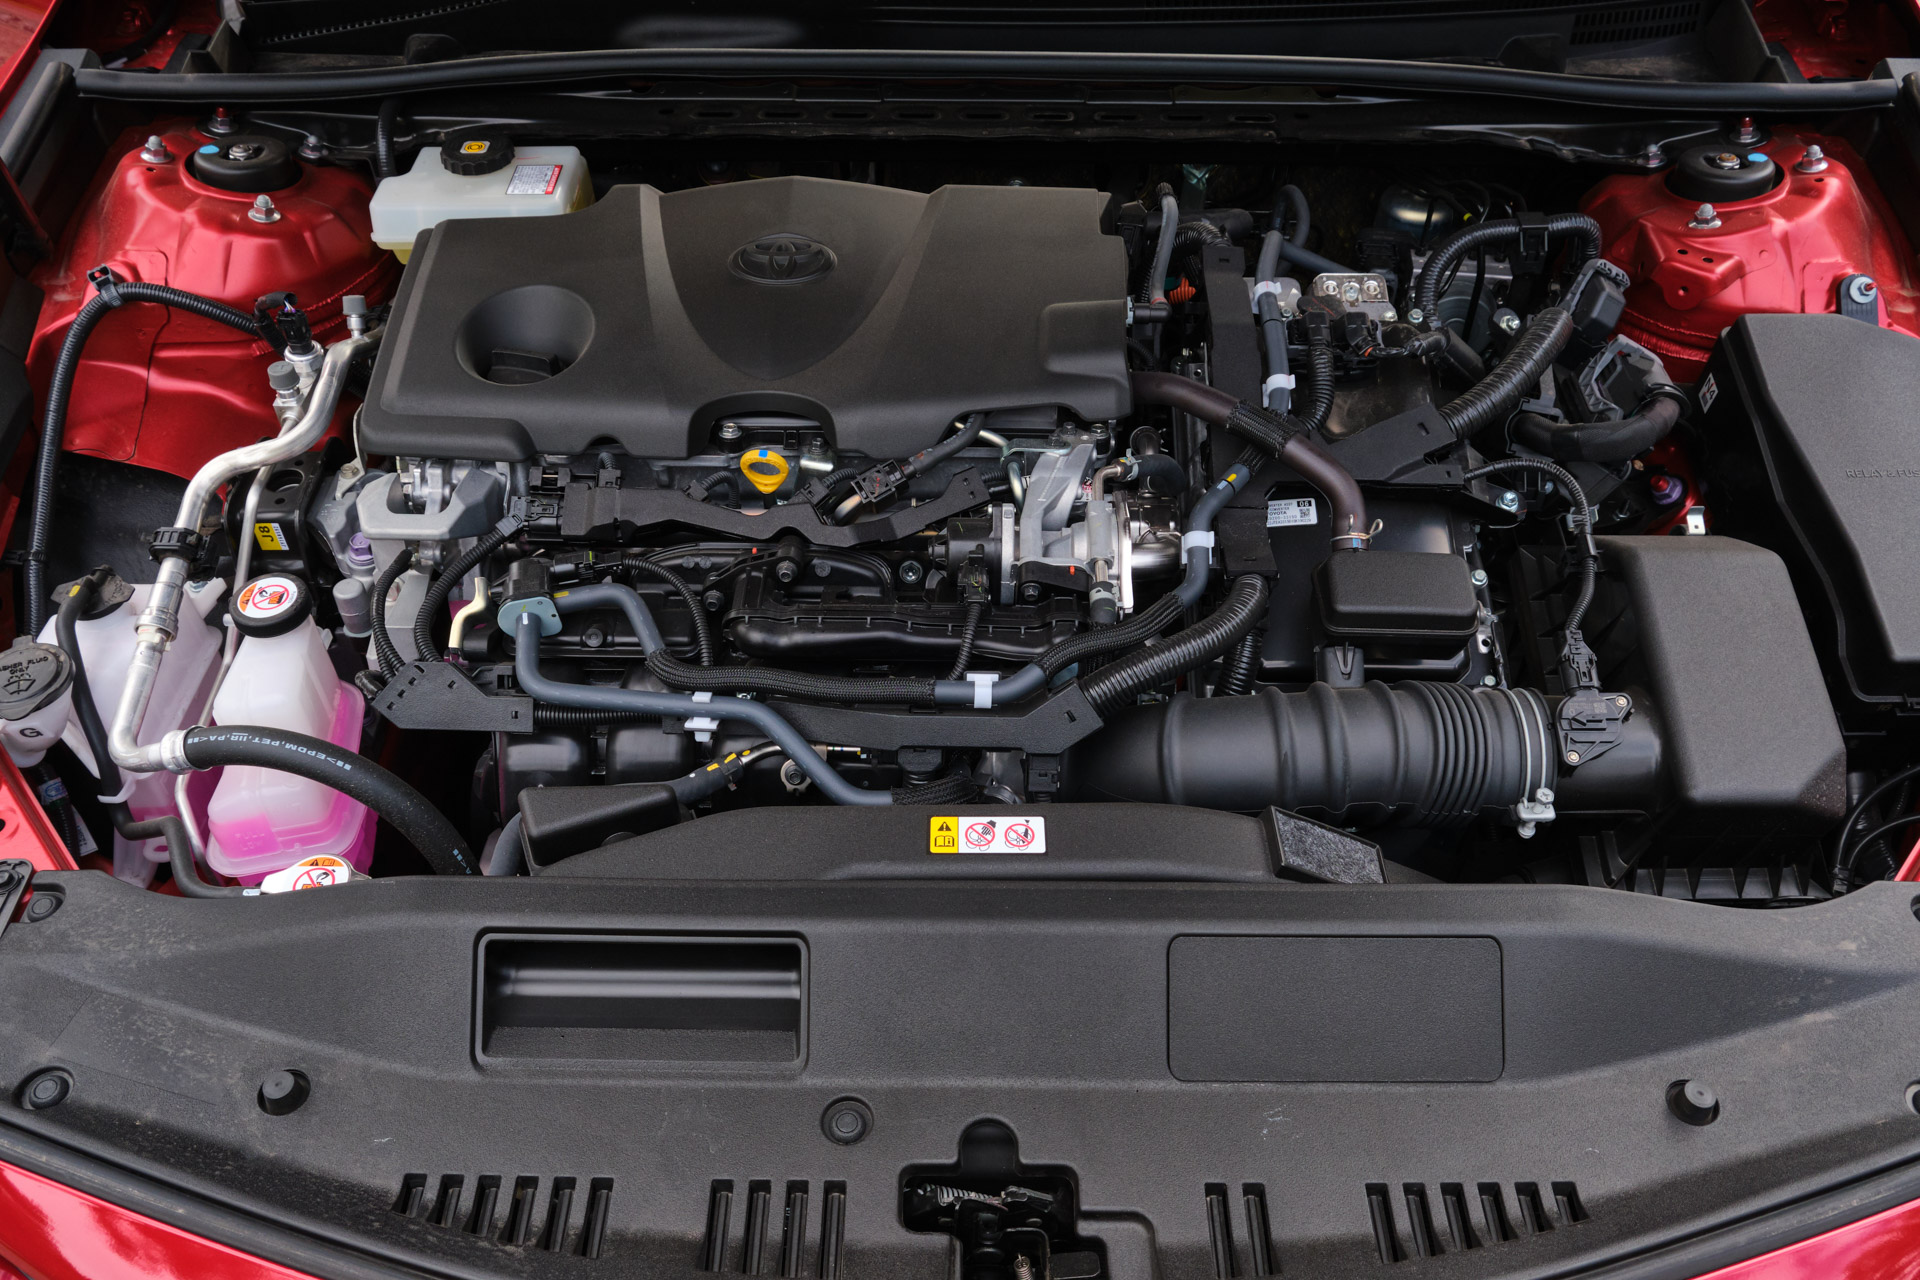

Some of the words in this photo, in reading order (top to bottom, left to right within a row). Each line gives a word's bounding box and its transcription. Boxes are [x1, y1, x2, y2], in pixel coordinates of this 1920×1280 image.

[1846, 469, 1882, 478] RELAY
[1887, 469, 1896, 477] &
[258, 526, 274, 542] J8
[27, 656, 49, 665] FLUID
[9, 665, 30, 675] ONLY
[19, 727, 44, 738] G
